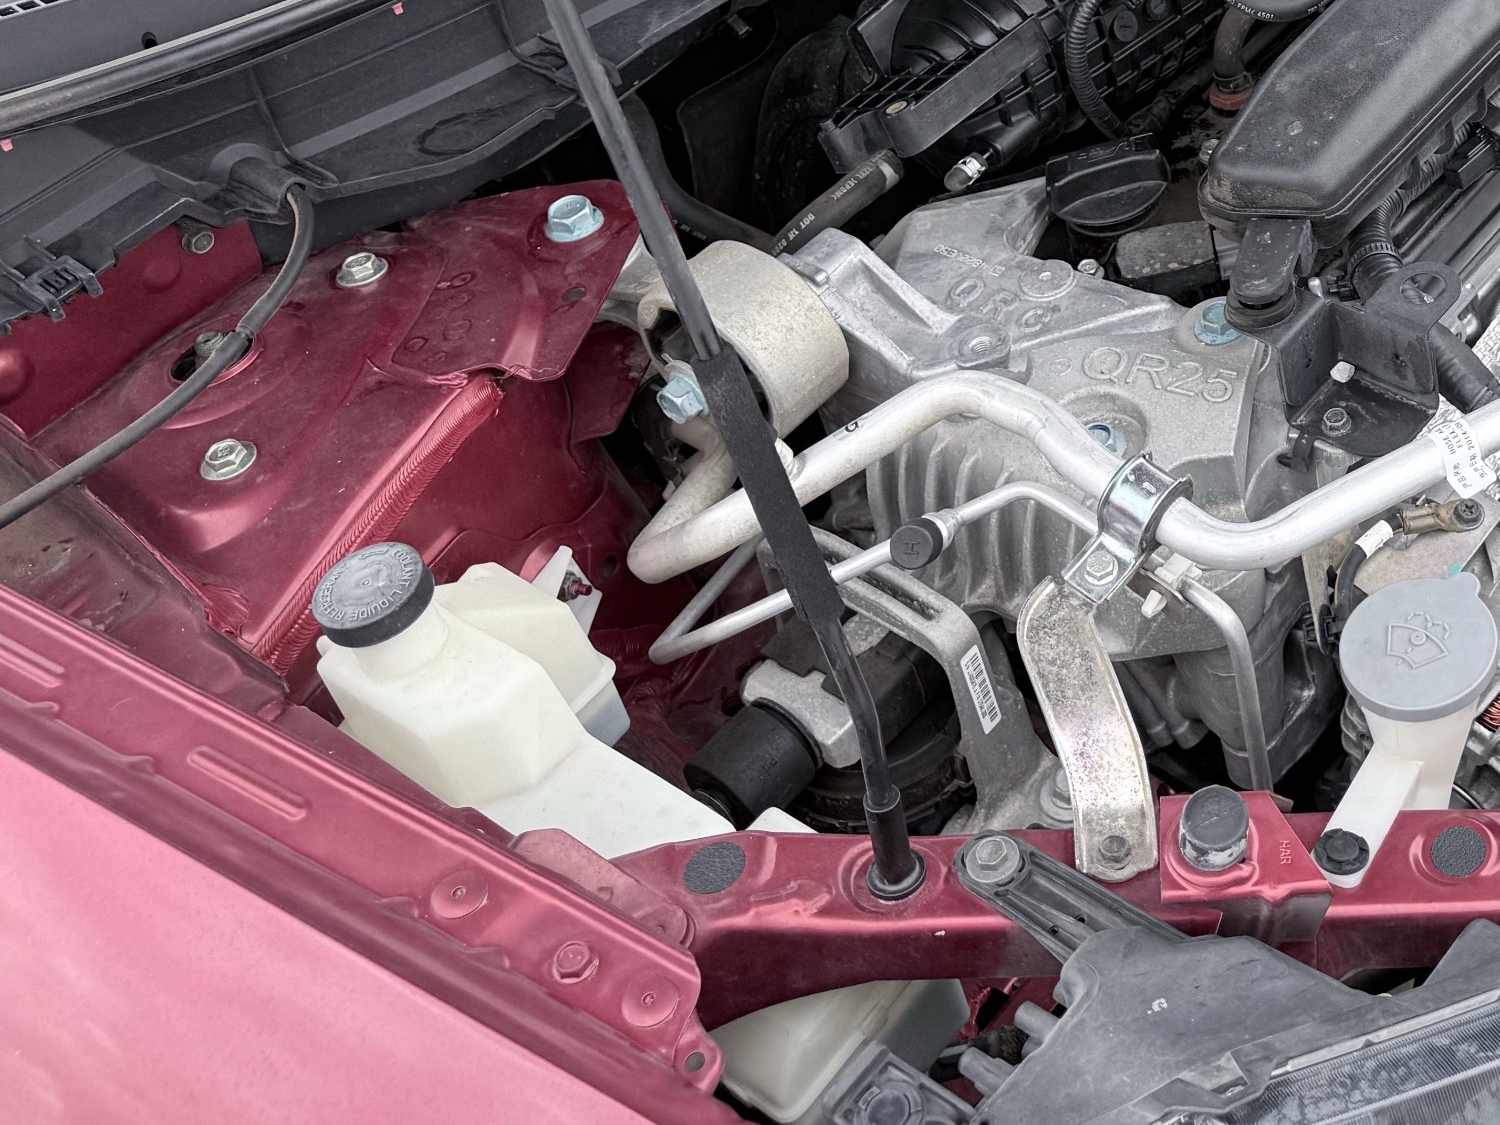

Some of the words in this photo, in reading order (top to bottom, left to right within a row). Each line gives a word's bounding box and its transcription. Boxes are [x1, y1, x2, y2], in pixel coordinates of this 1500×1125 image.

[1082, 346, 1238, 404] QR25
[392, 549, 415, 588] COOLANT
[348, 589, 403, 621] LIQUIDE
